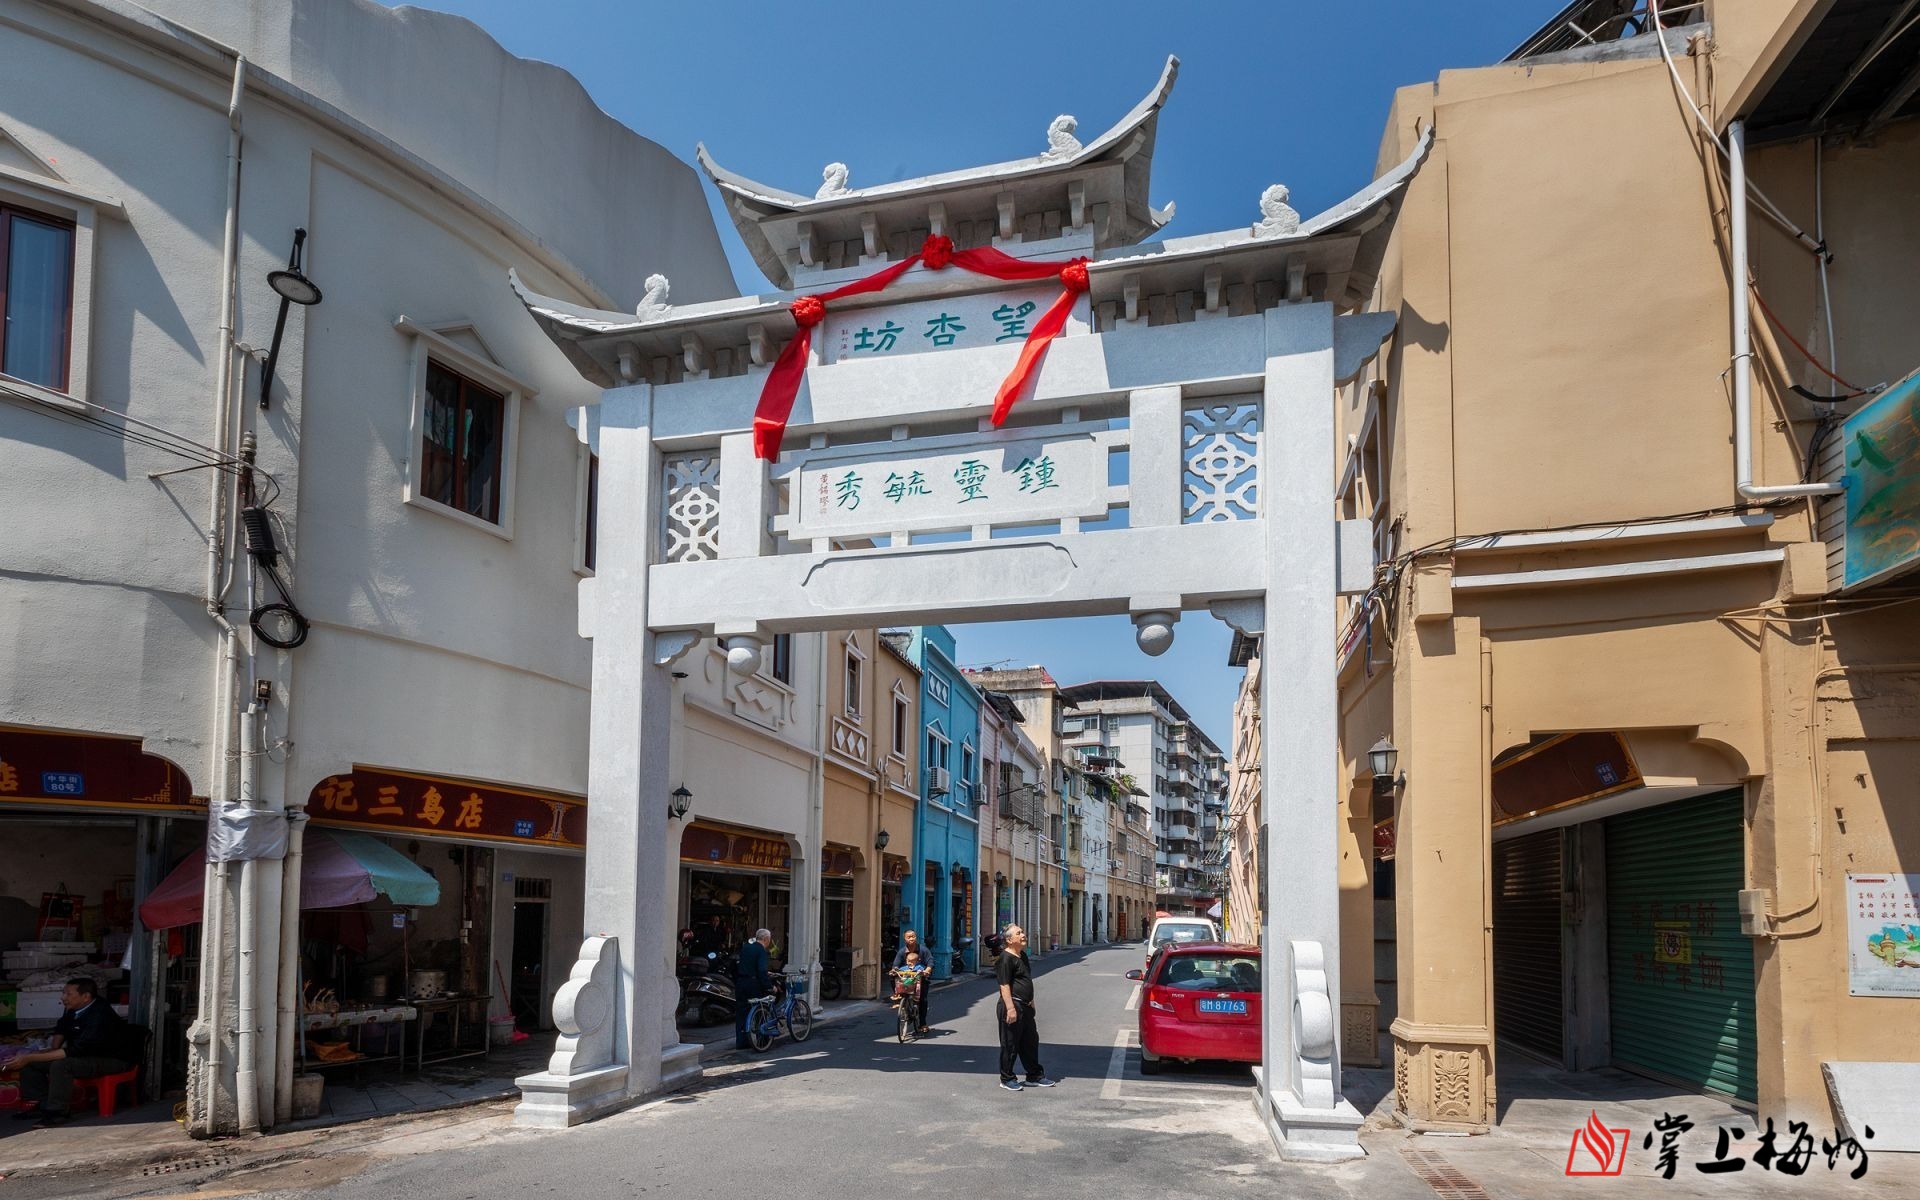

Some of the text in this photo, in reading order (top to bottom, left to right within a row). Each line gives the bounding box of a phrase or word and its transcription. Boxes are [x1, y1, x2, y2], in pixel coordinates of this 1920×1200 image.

[854, 301, 1036, 352] 望杏坊
[835, 455, 1060, 510] 鍾靈毓秀
[51, 783, 76, 792] 80号
